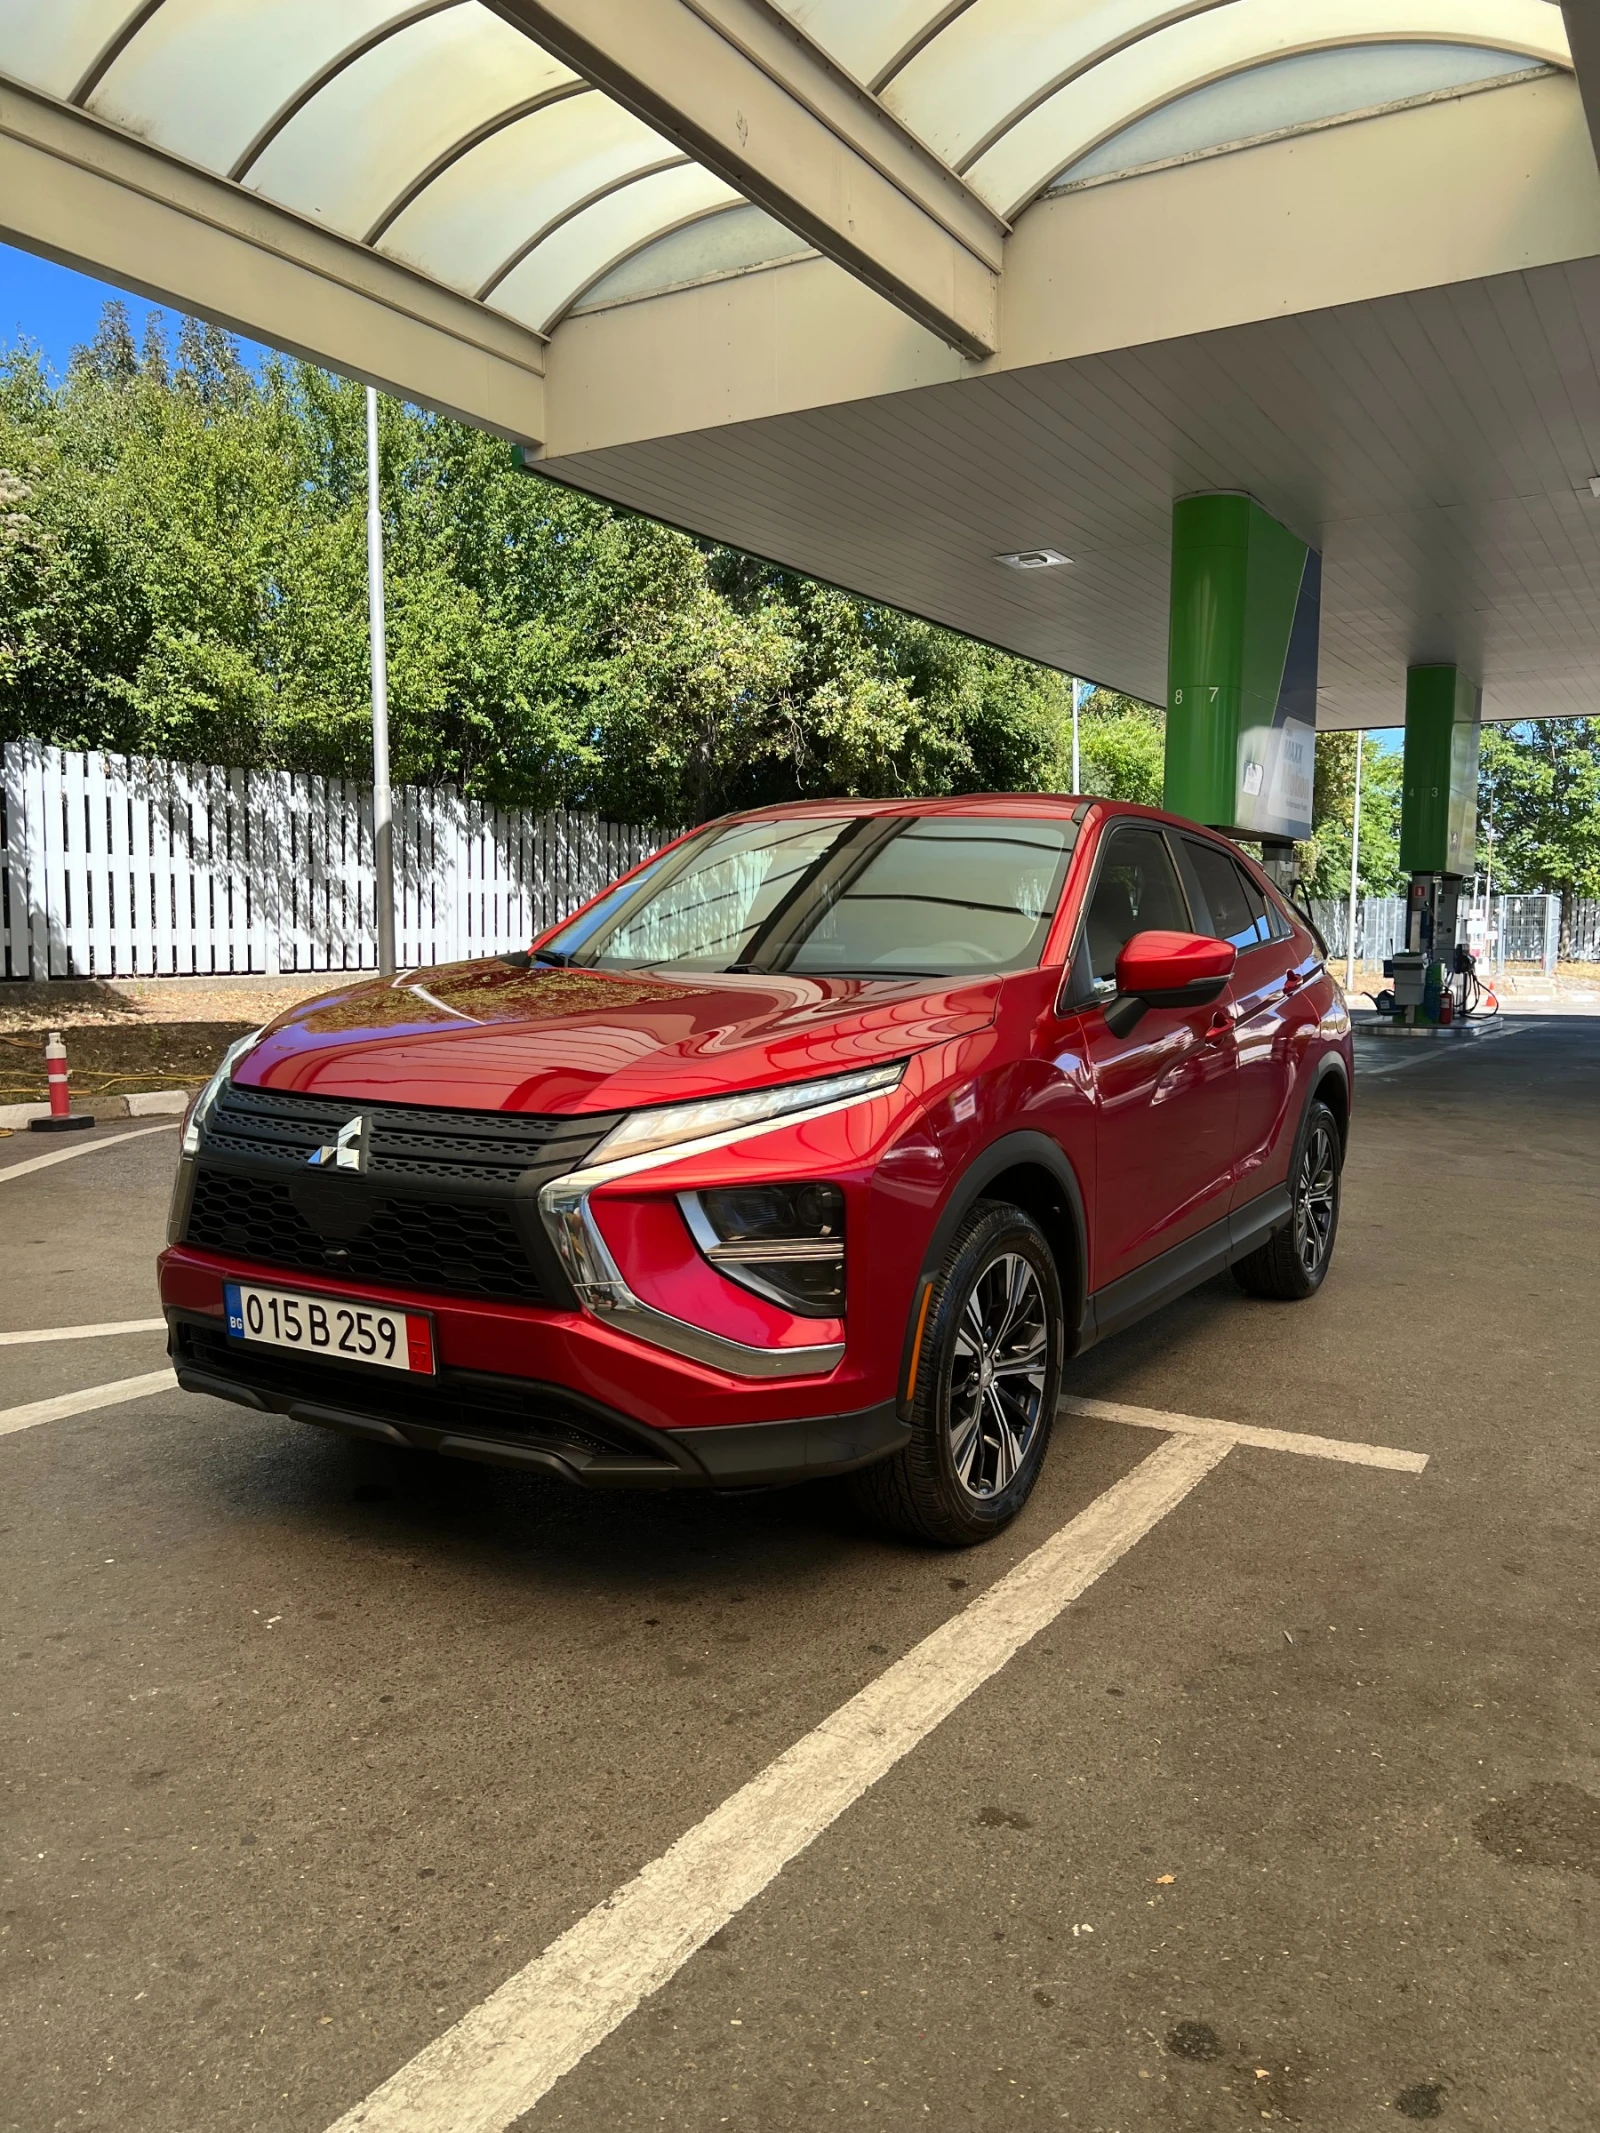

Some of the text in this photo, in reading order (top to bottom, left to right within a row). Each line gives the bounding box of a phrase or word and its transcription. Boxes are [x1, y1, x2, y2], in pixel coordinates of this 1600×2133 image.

[1175, 686, 1220, 705] 8 7
[1408, 787, 1439, 798] 4 3
[229, 1316, 243, 1330] BG
